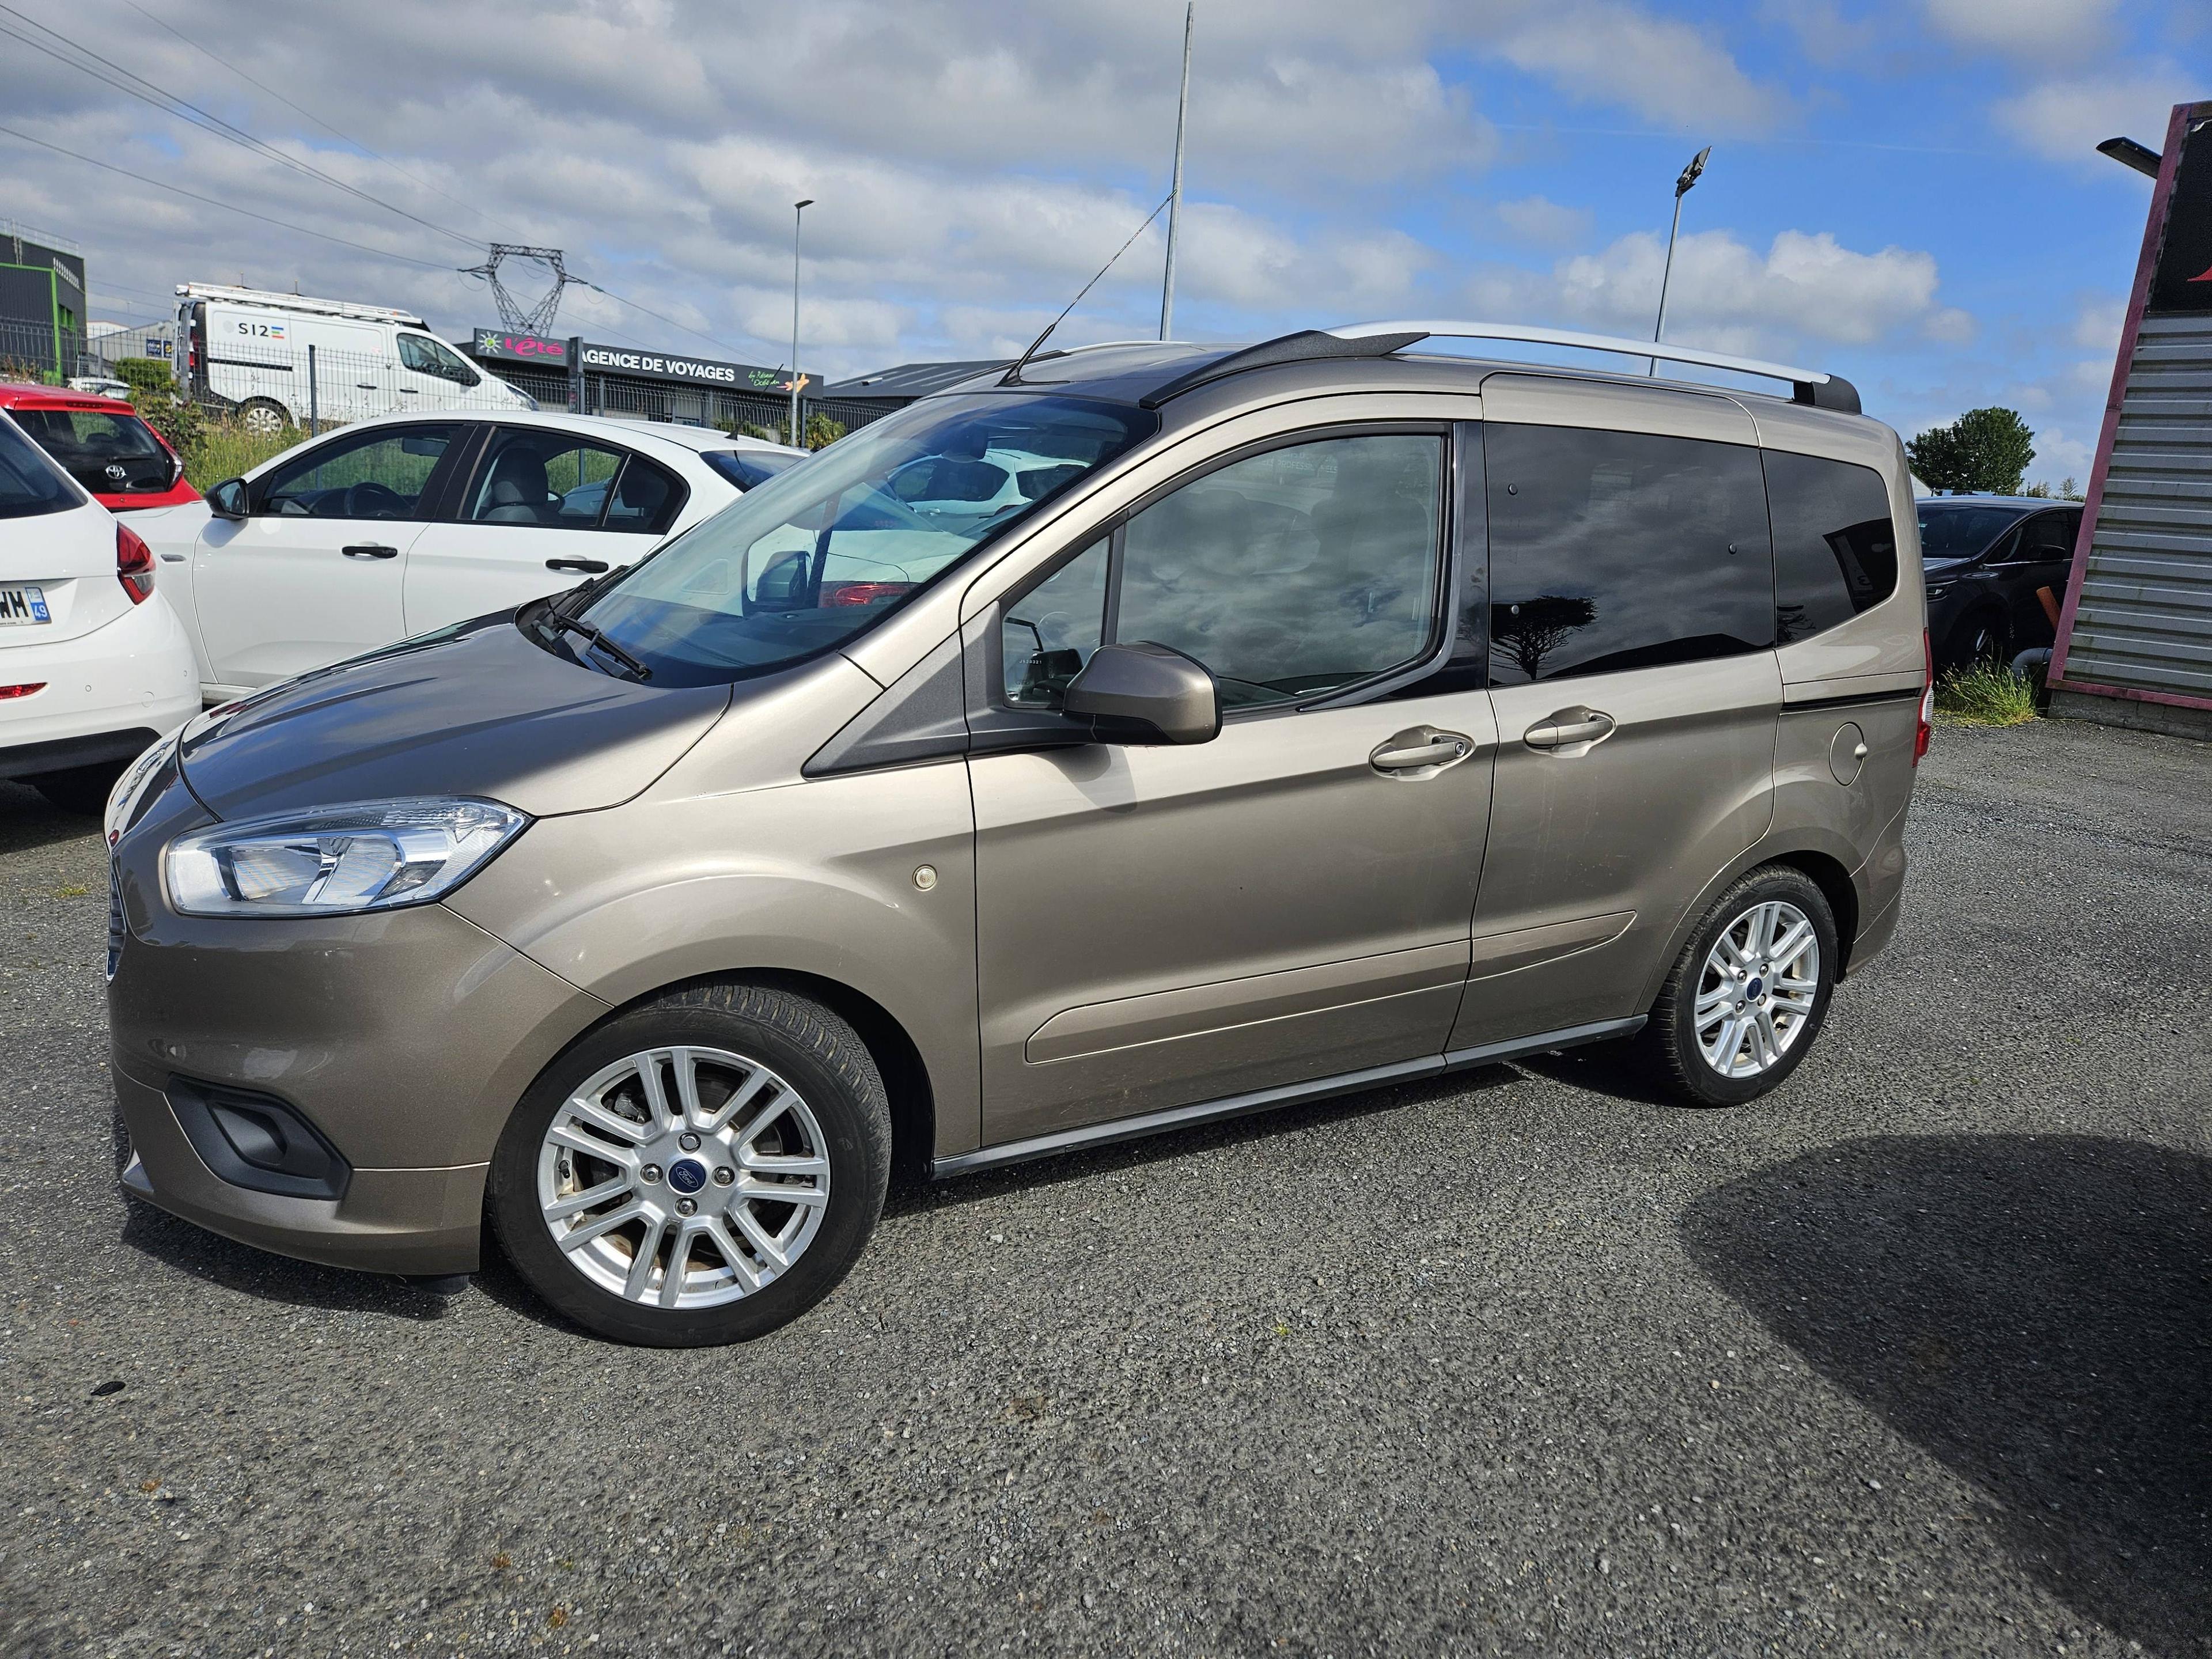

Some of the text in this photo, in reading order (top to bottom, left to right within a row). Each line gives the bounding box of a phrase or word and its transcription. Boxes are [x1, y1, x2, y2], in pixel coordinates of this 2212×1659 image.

[642, 357, 663, 372] DE
[665, 360, 735, 382] VOYAGES
[35, 605, 47, 618] 49
